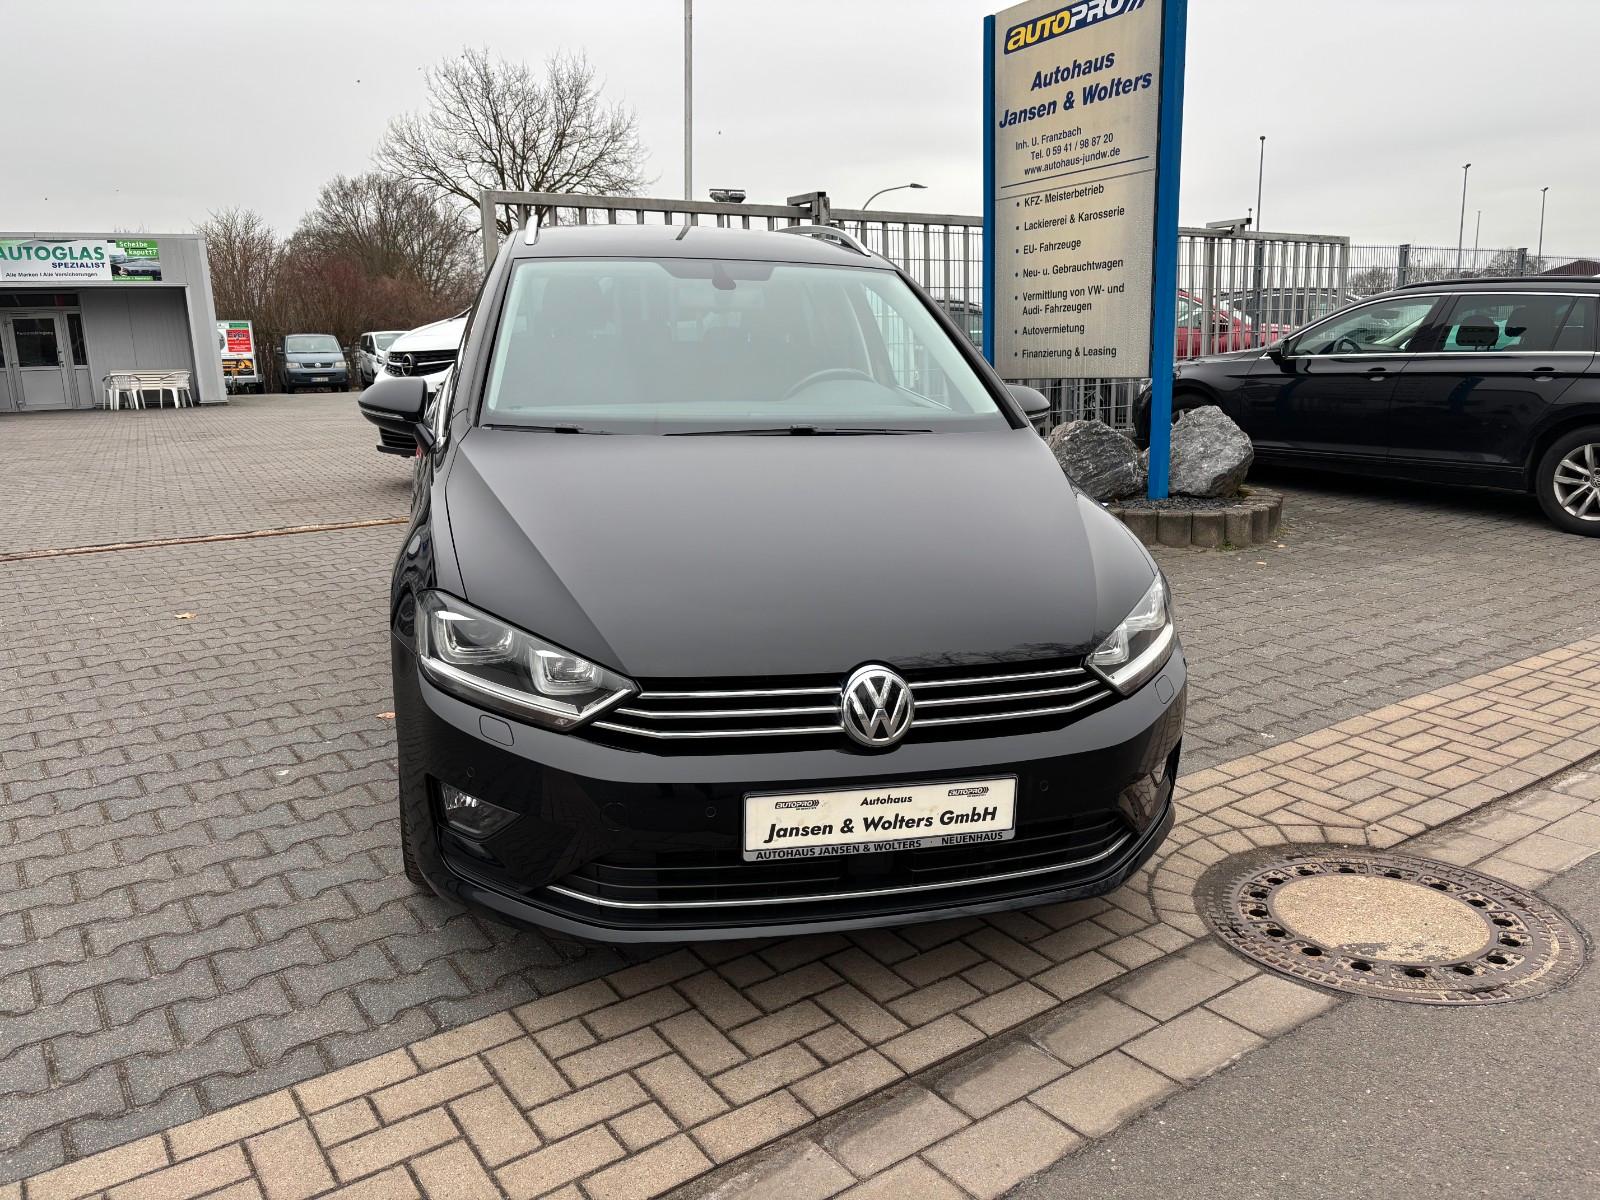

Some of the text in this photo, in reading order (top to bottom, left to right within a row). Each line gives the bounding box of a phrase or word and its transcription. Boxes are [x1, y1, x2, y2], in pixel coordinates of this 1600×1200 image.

[1030, 52, 1115, 91] Autohaus
[999, 72, 1153, 128] Jansen & Wolters
[1015, 126, 1082, 150] Inh. U. Franzbach
[1031, 149, 1044, 160] Tel.
[1046, 146, 1051, 157] 0
[1052, 144, 1061, 155] 59
[1063, 143, 1072, 153] 41
[1079, 138, 1090, 149] 98
[1091, 136, 1101, 147] 87
[1103, 132, 1114, 143] 20
[1024, 147, 1121, 176] www.autohaus-jundw.de
[1024, 184, 1105, 208] KFZ- Meisterbetrieb
[1024, 206, 1125, 231] Lackiererei & Karosserie
[0, 246, 105, 261] AUTOGLAS
[1023, 239, 1082, 255] EU- Fahrzeuge
[1022, 258, 1124, 278] Neu- u. Gebrauchtwagen
[1022, 282, 1124, 301] Vermittlung von VW- und
[1022, 301, 1092, 316] Audi- Fahrzeugen
[1022, 323, 1085, 336] Autovermietung
[1022, 346, 1117, 359] Finanzierung & Leasing
[860, 794, 913, 807] Autohaus
[763, 806, 998, 844] Jansen & Wolters GmbH
[755, 831, 1003, 861] AUTOHAUS JANSEN & WOLTERS NEUENHAUS
